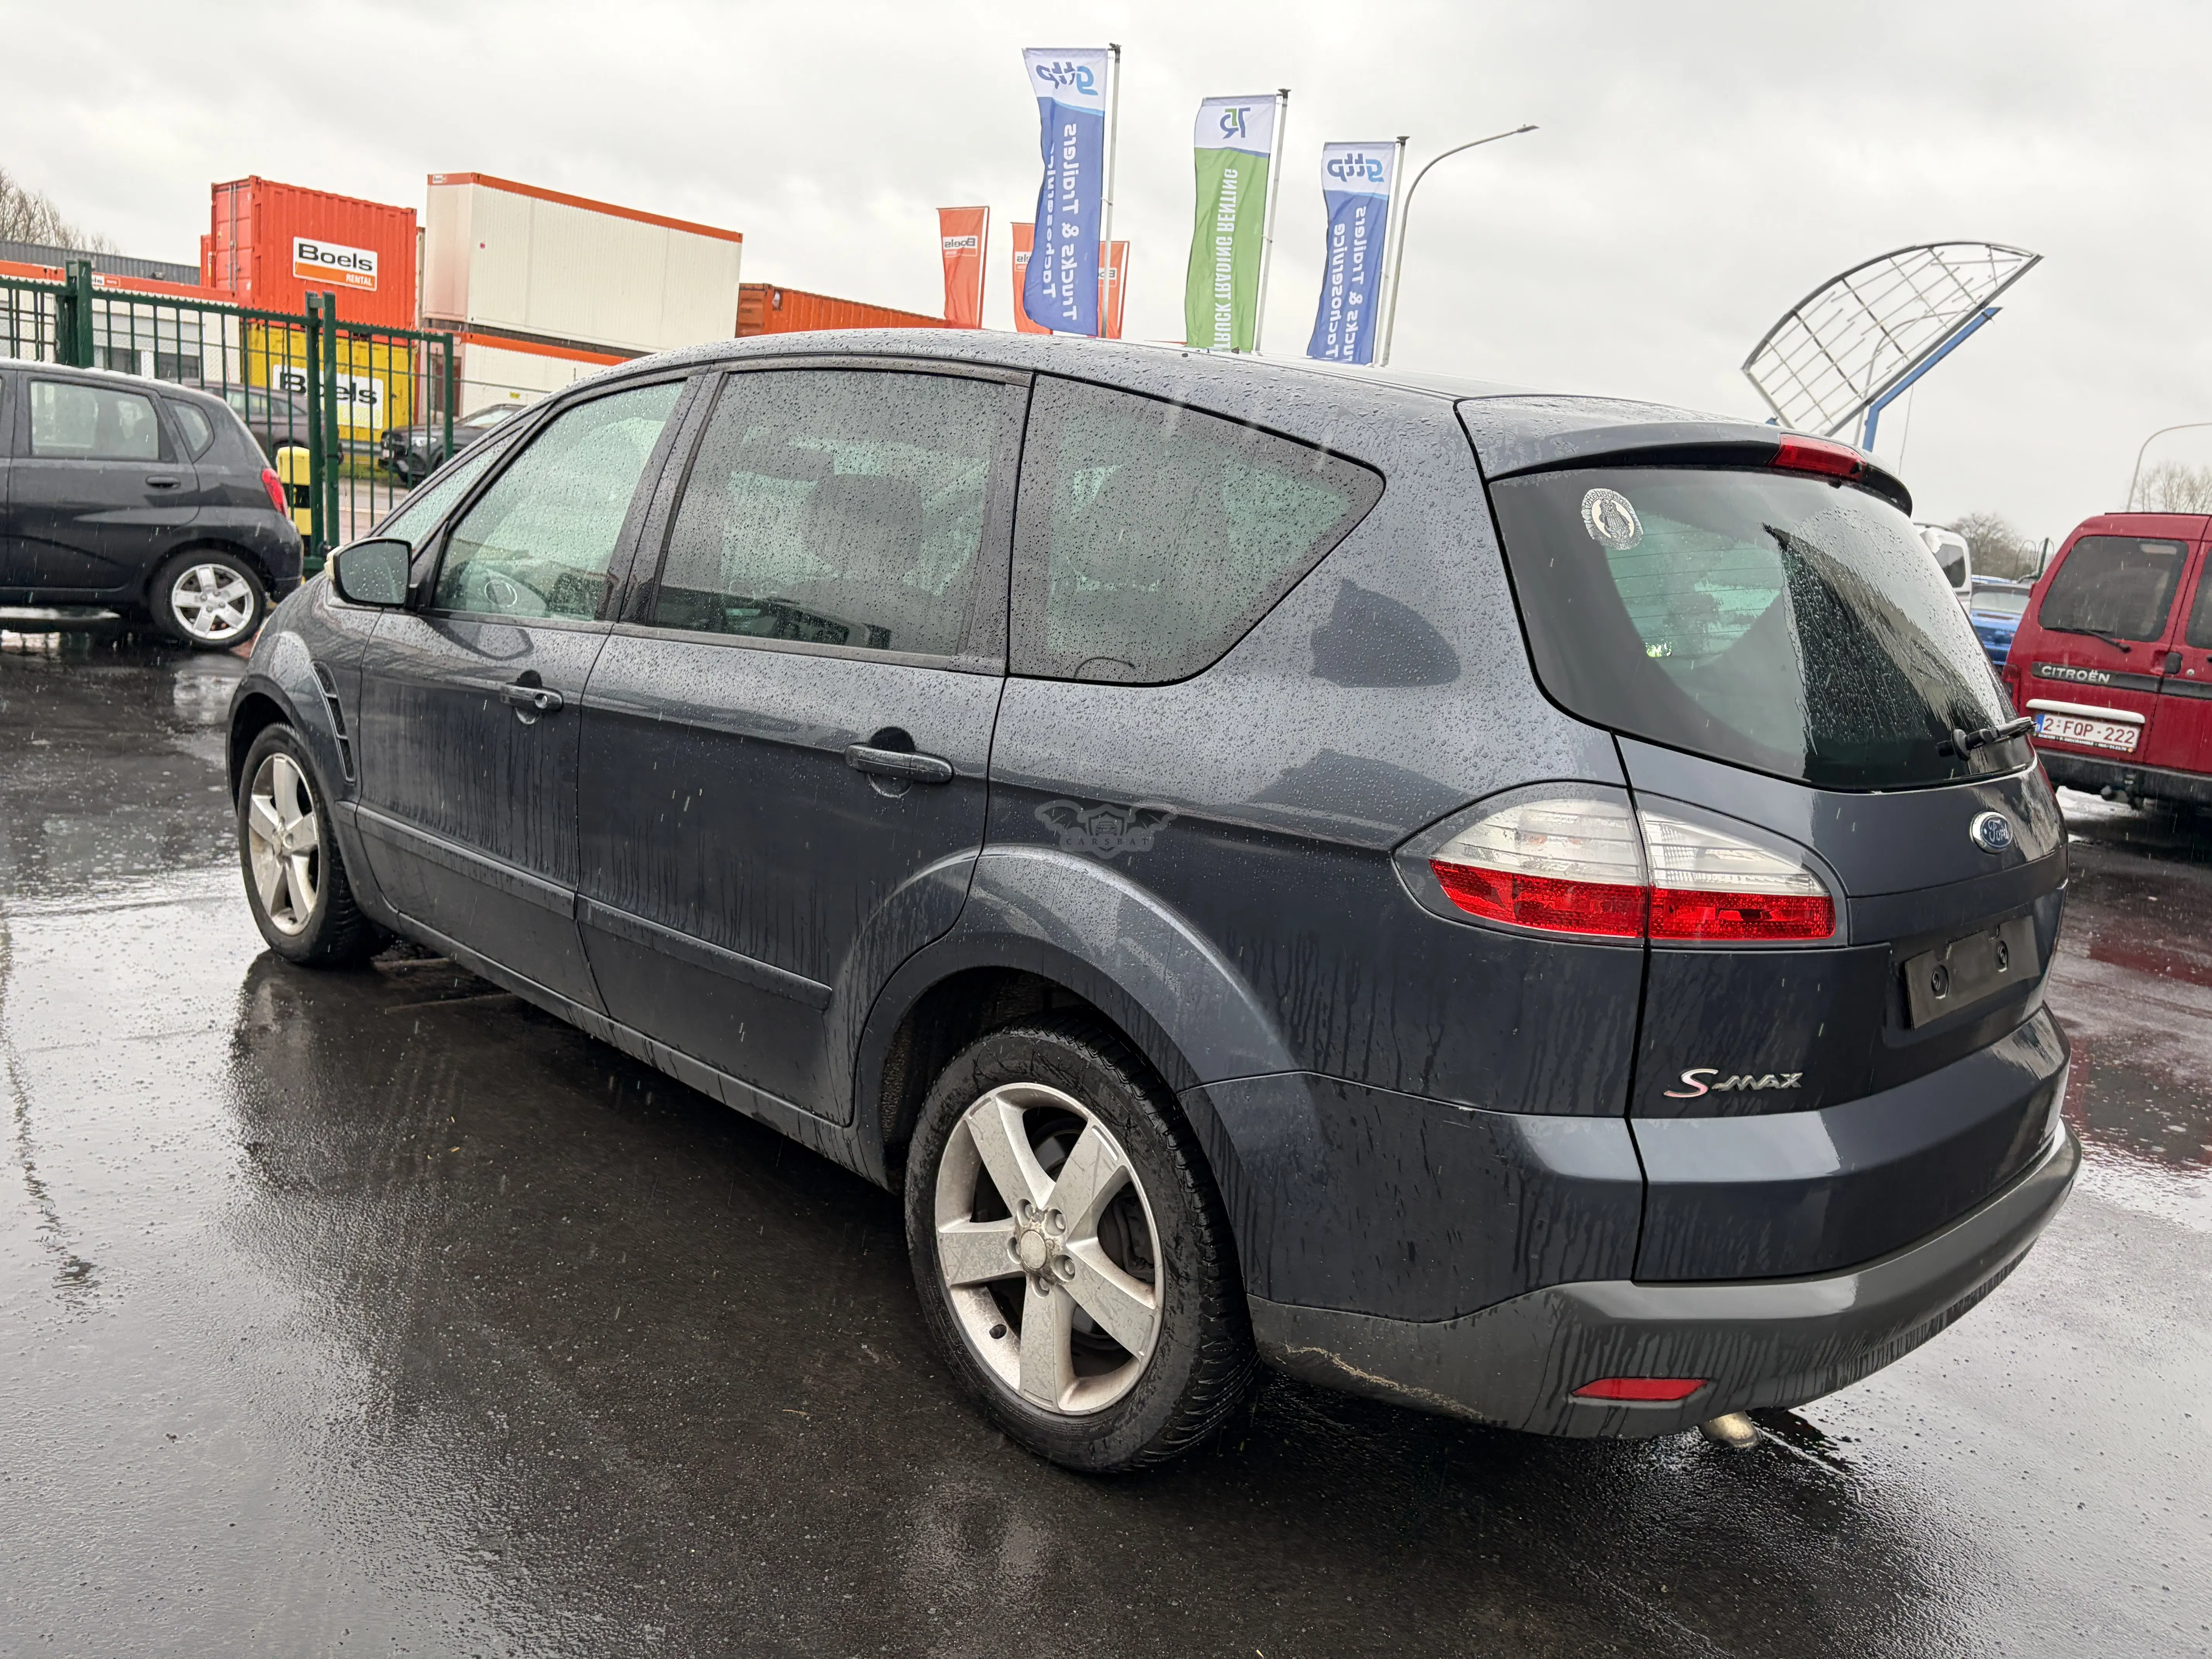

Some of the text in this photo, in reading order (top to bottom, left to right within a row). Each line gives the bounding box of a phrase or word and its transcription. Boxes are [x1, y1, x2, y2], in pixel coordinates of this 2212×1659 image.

[299, 242, 373, 271] Boels
[346, 273, 372, 286] RENTAL
[2041, 665, 2110, 684] CITROËN
[1988, 819, 2009, 843] Ford
